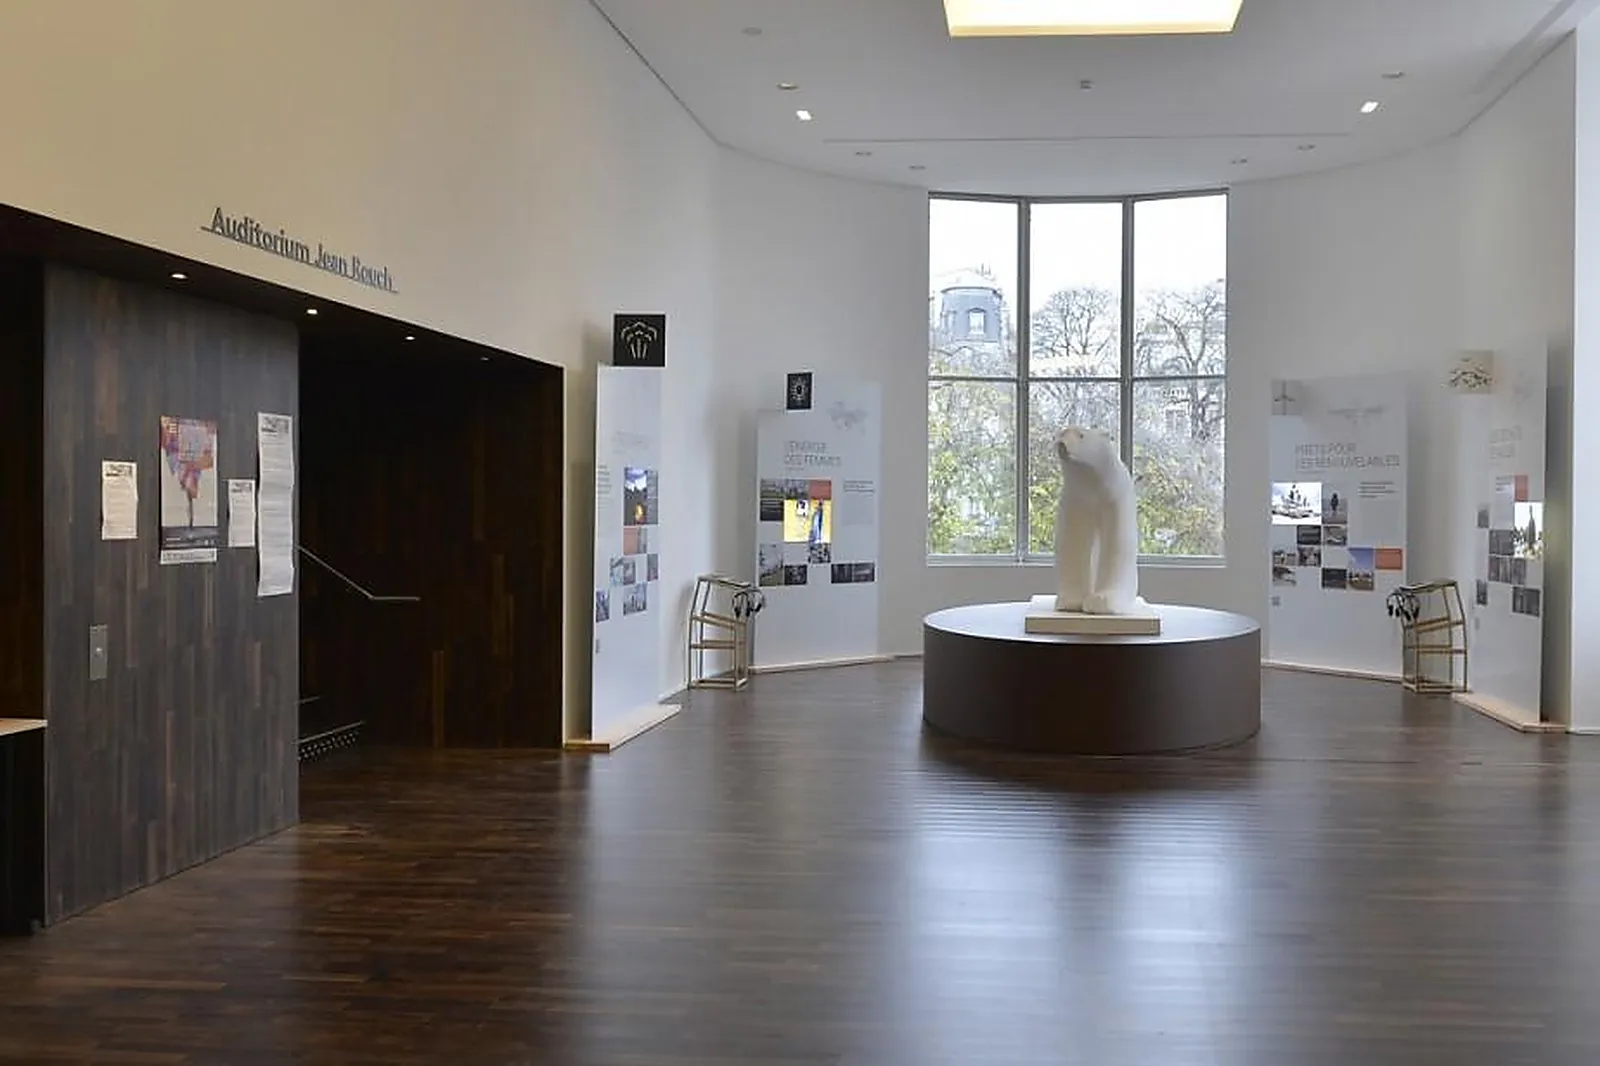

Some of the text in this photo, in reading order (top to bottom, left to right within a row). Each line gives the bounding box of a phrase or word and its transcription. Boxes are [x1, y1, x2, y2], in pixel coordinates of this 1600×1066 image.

[209, 206, 393, 292] Auditorium Jean Rouch
